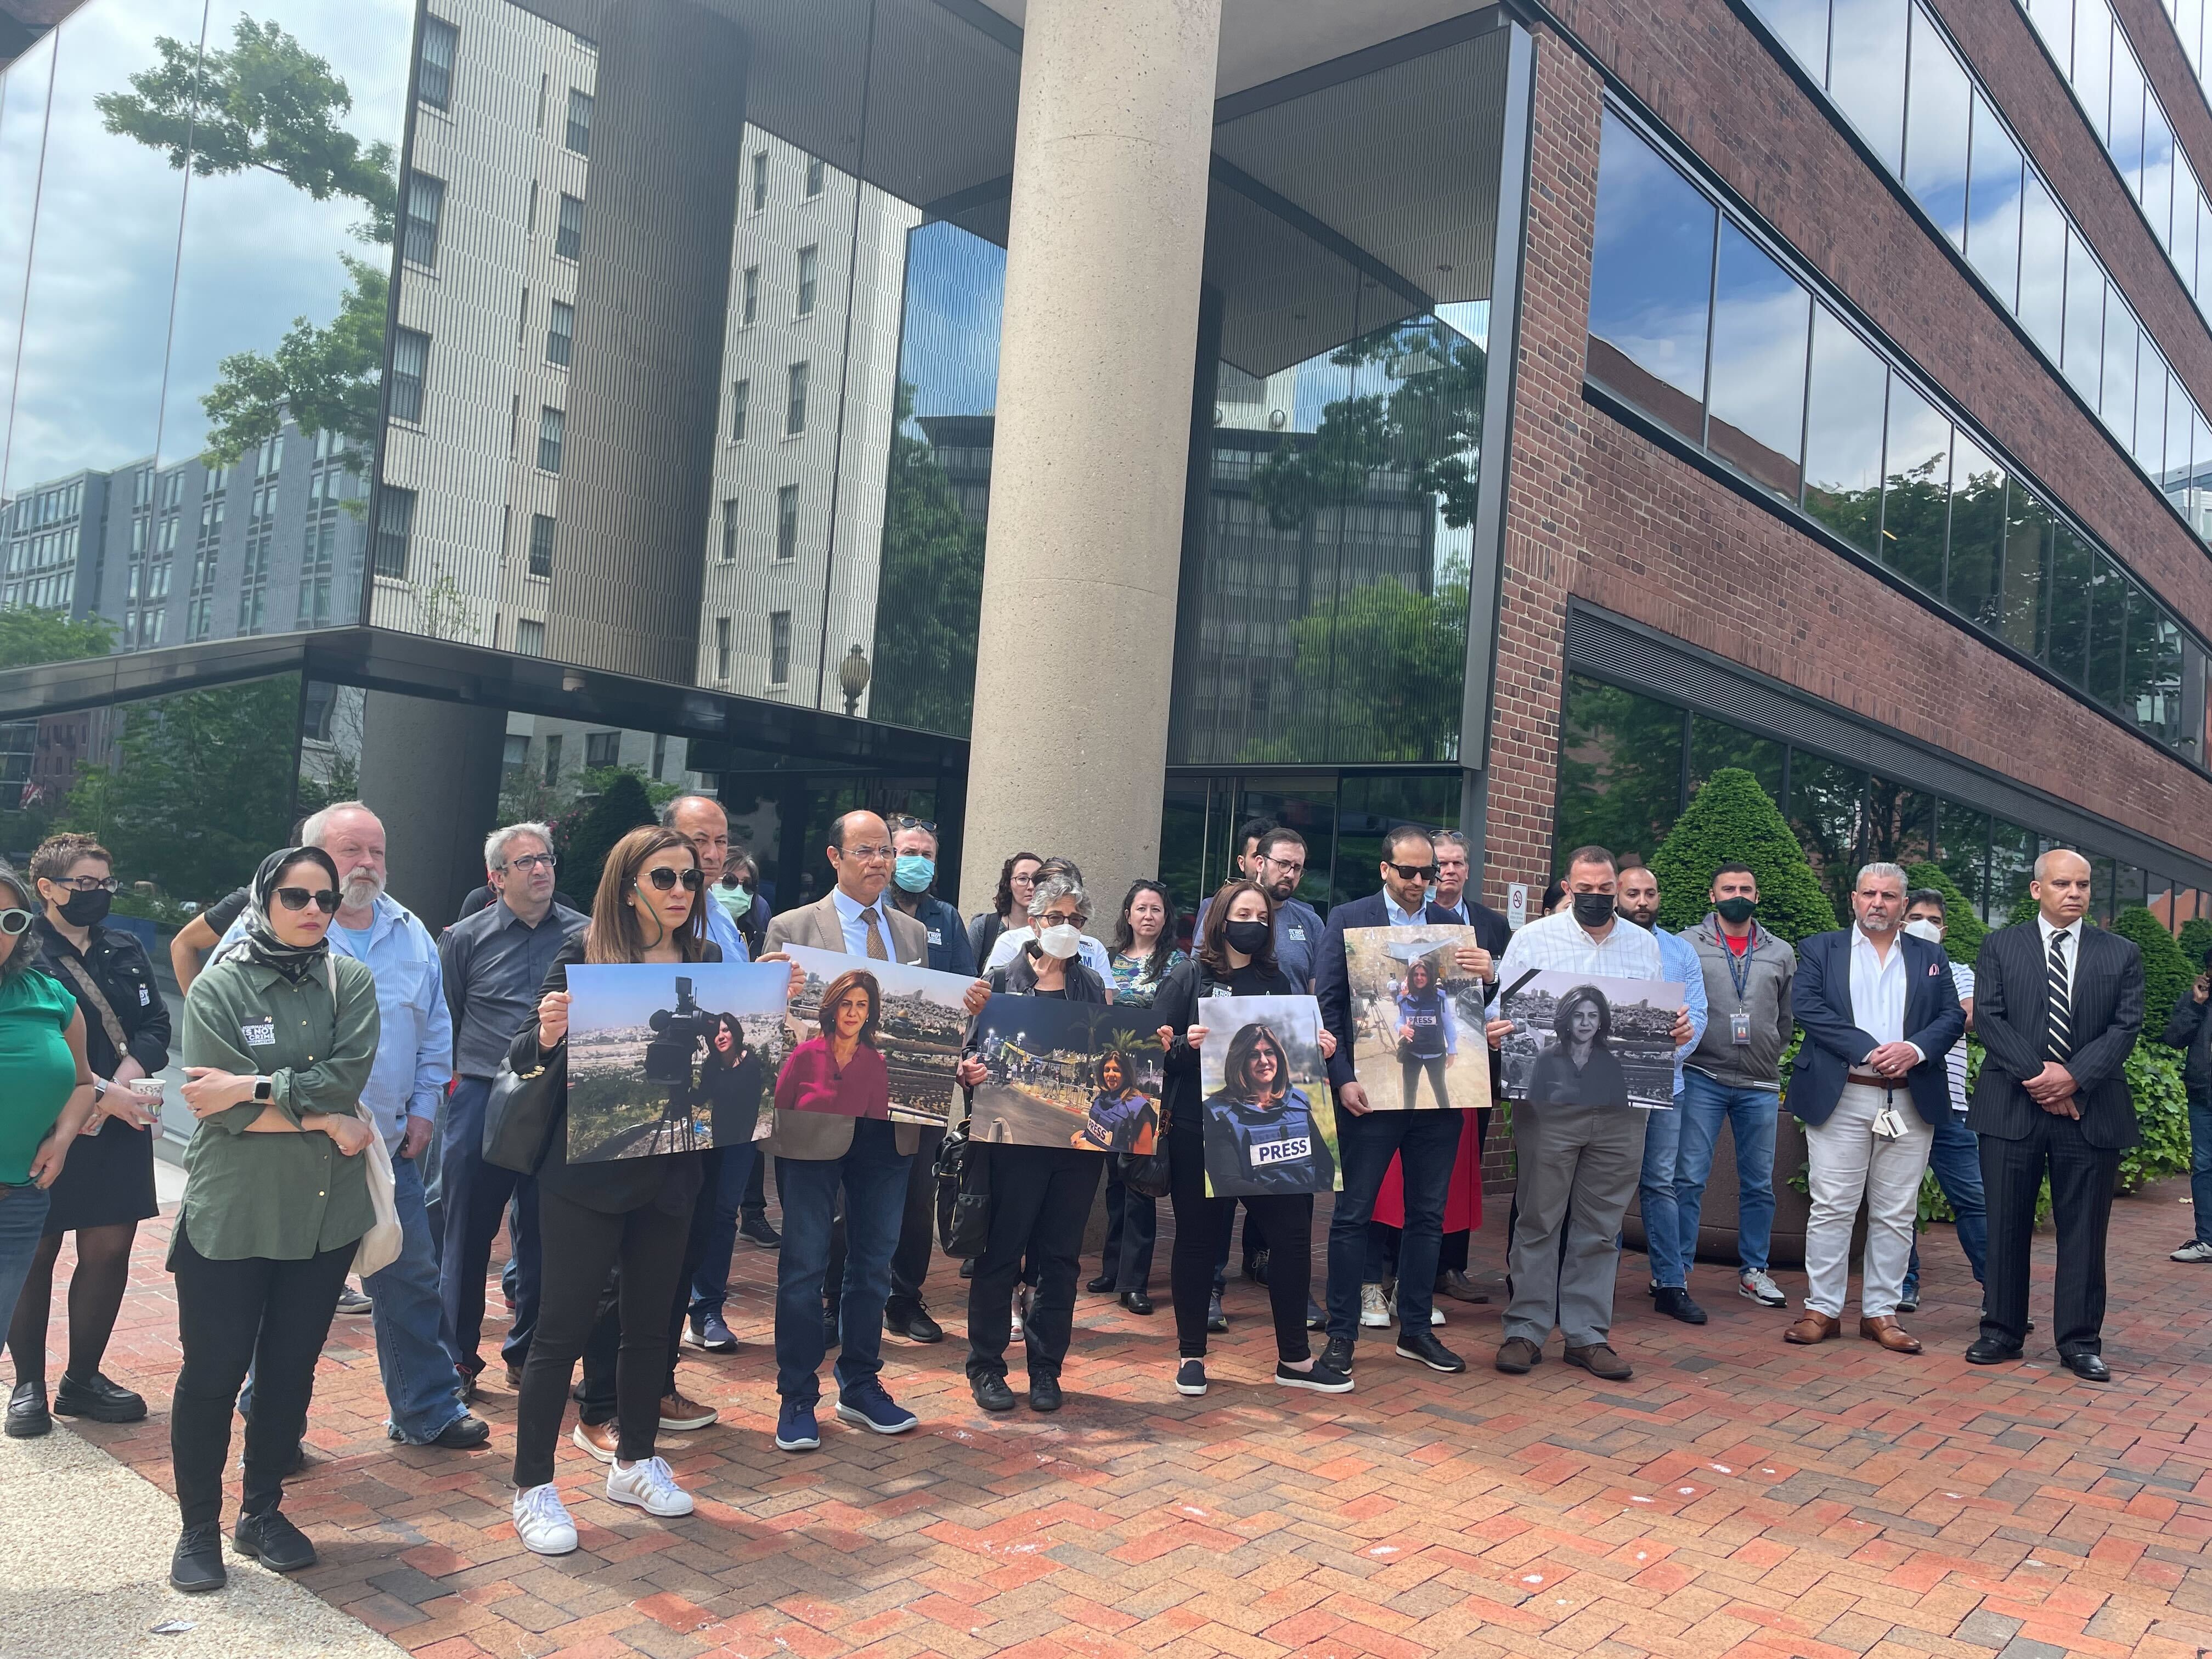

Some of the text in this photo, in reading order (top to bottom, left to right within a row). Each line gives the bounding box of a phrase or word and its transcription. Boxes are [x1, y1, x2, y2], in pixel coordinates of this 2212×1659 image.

[1080, 956, 1092, 967] M
[1088, 1119, 1107, 1140] PRESS
[1259, 1139, 1307, 1161] PRESS
